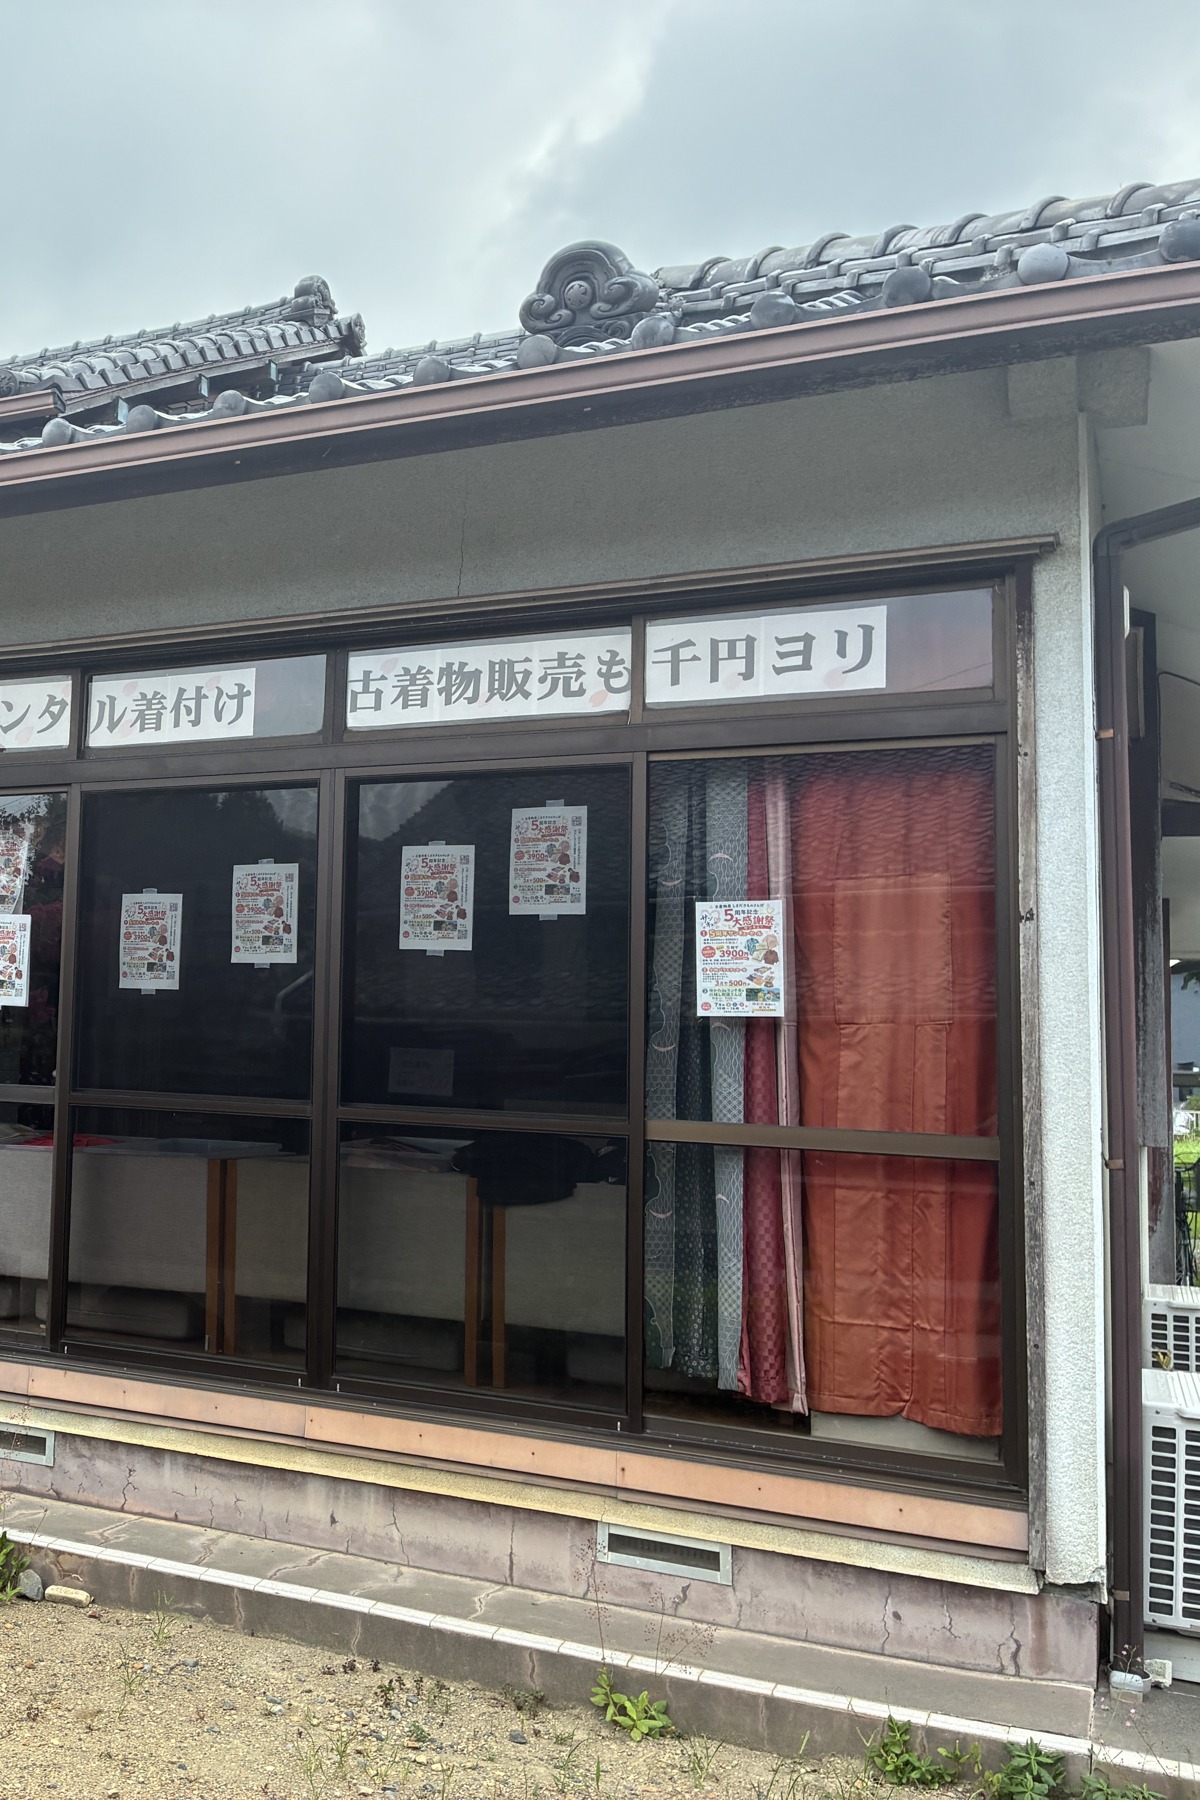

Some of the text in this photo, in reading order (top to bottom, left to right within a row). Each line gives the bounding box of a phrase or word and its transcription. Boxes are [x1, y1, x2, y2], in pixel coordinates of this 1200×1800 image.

[651, 623, 875, 687] 千円ヨリ
[732, 915, 775, 928] 大感謝祭
